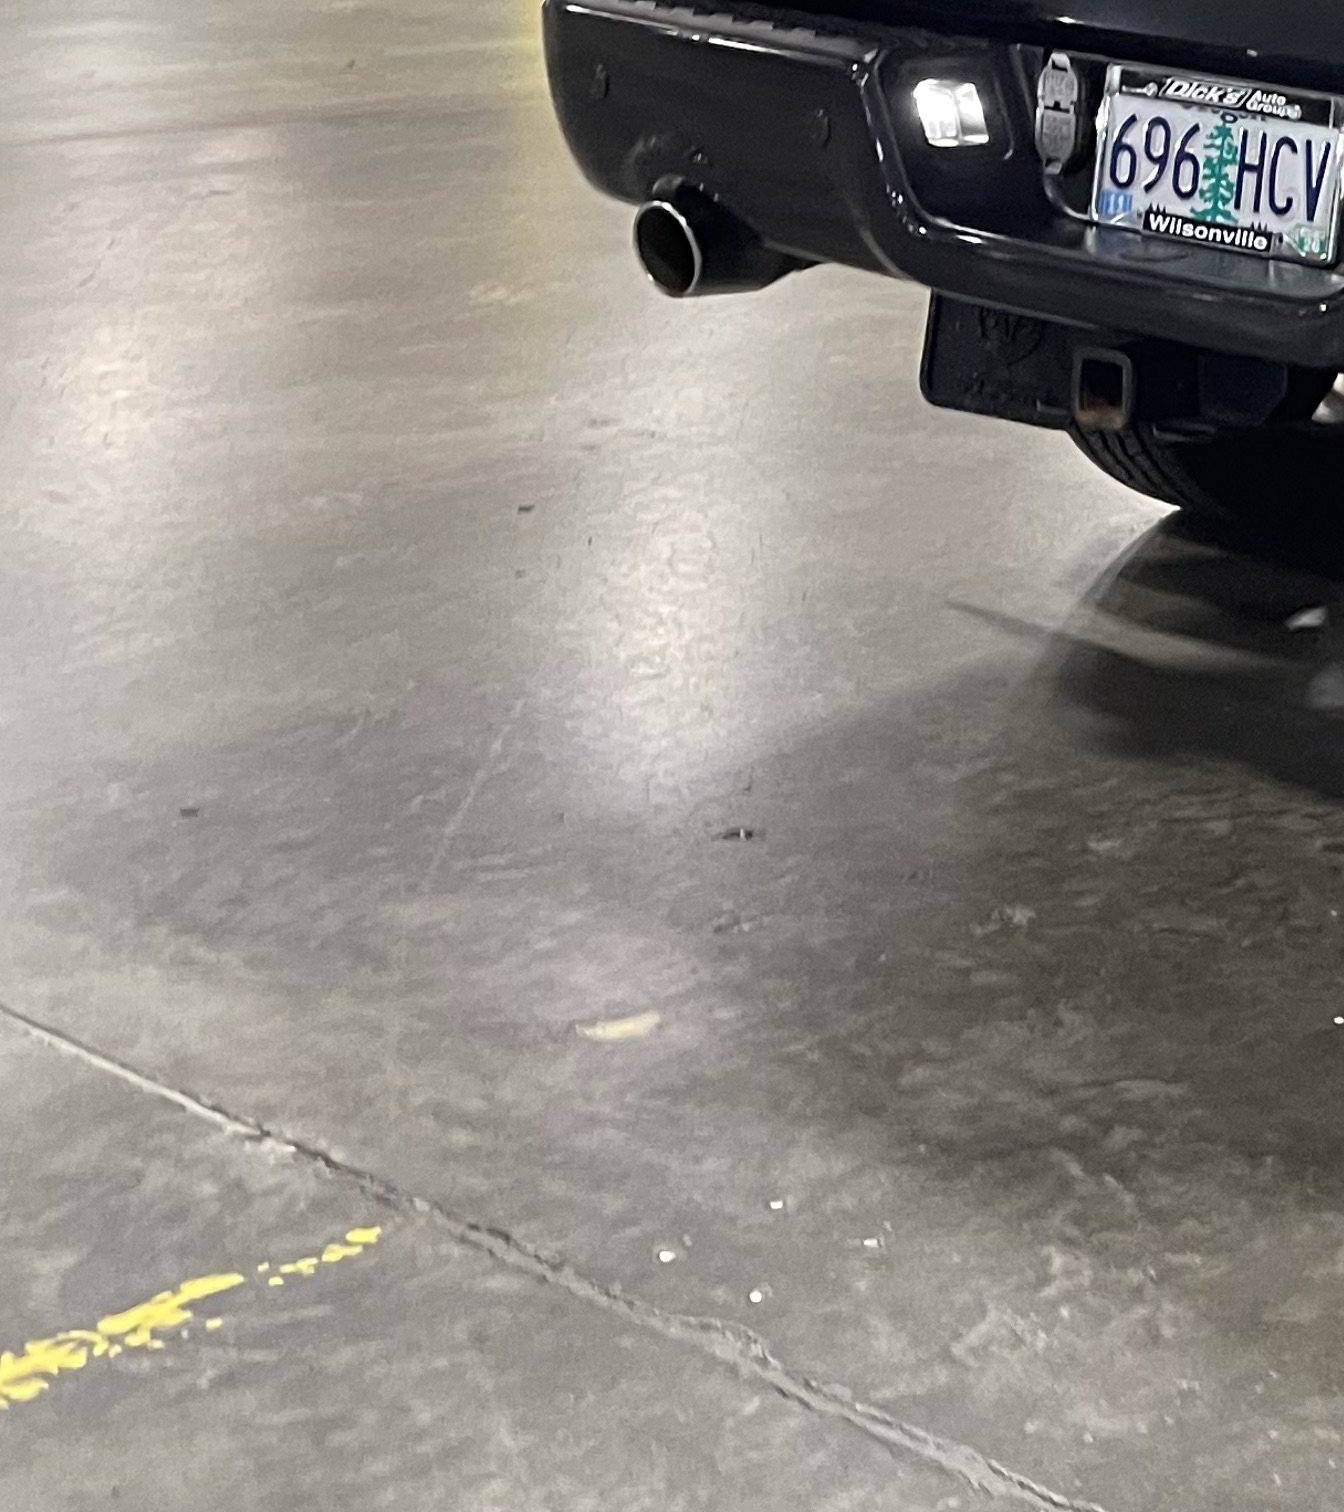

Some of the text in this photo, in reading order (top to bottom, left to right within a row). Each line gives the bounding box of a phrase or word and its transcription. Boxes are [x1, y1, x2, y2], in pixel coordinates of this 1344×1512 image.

[1250, 89, 1287, 106] Auto
[1109, 113, 1332, 222] 696 HCV
[1149, 212, 1268, 251] Wilsonville
